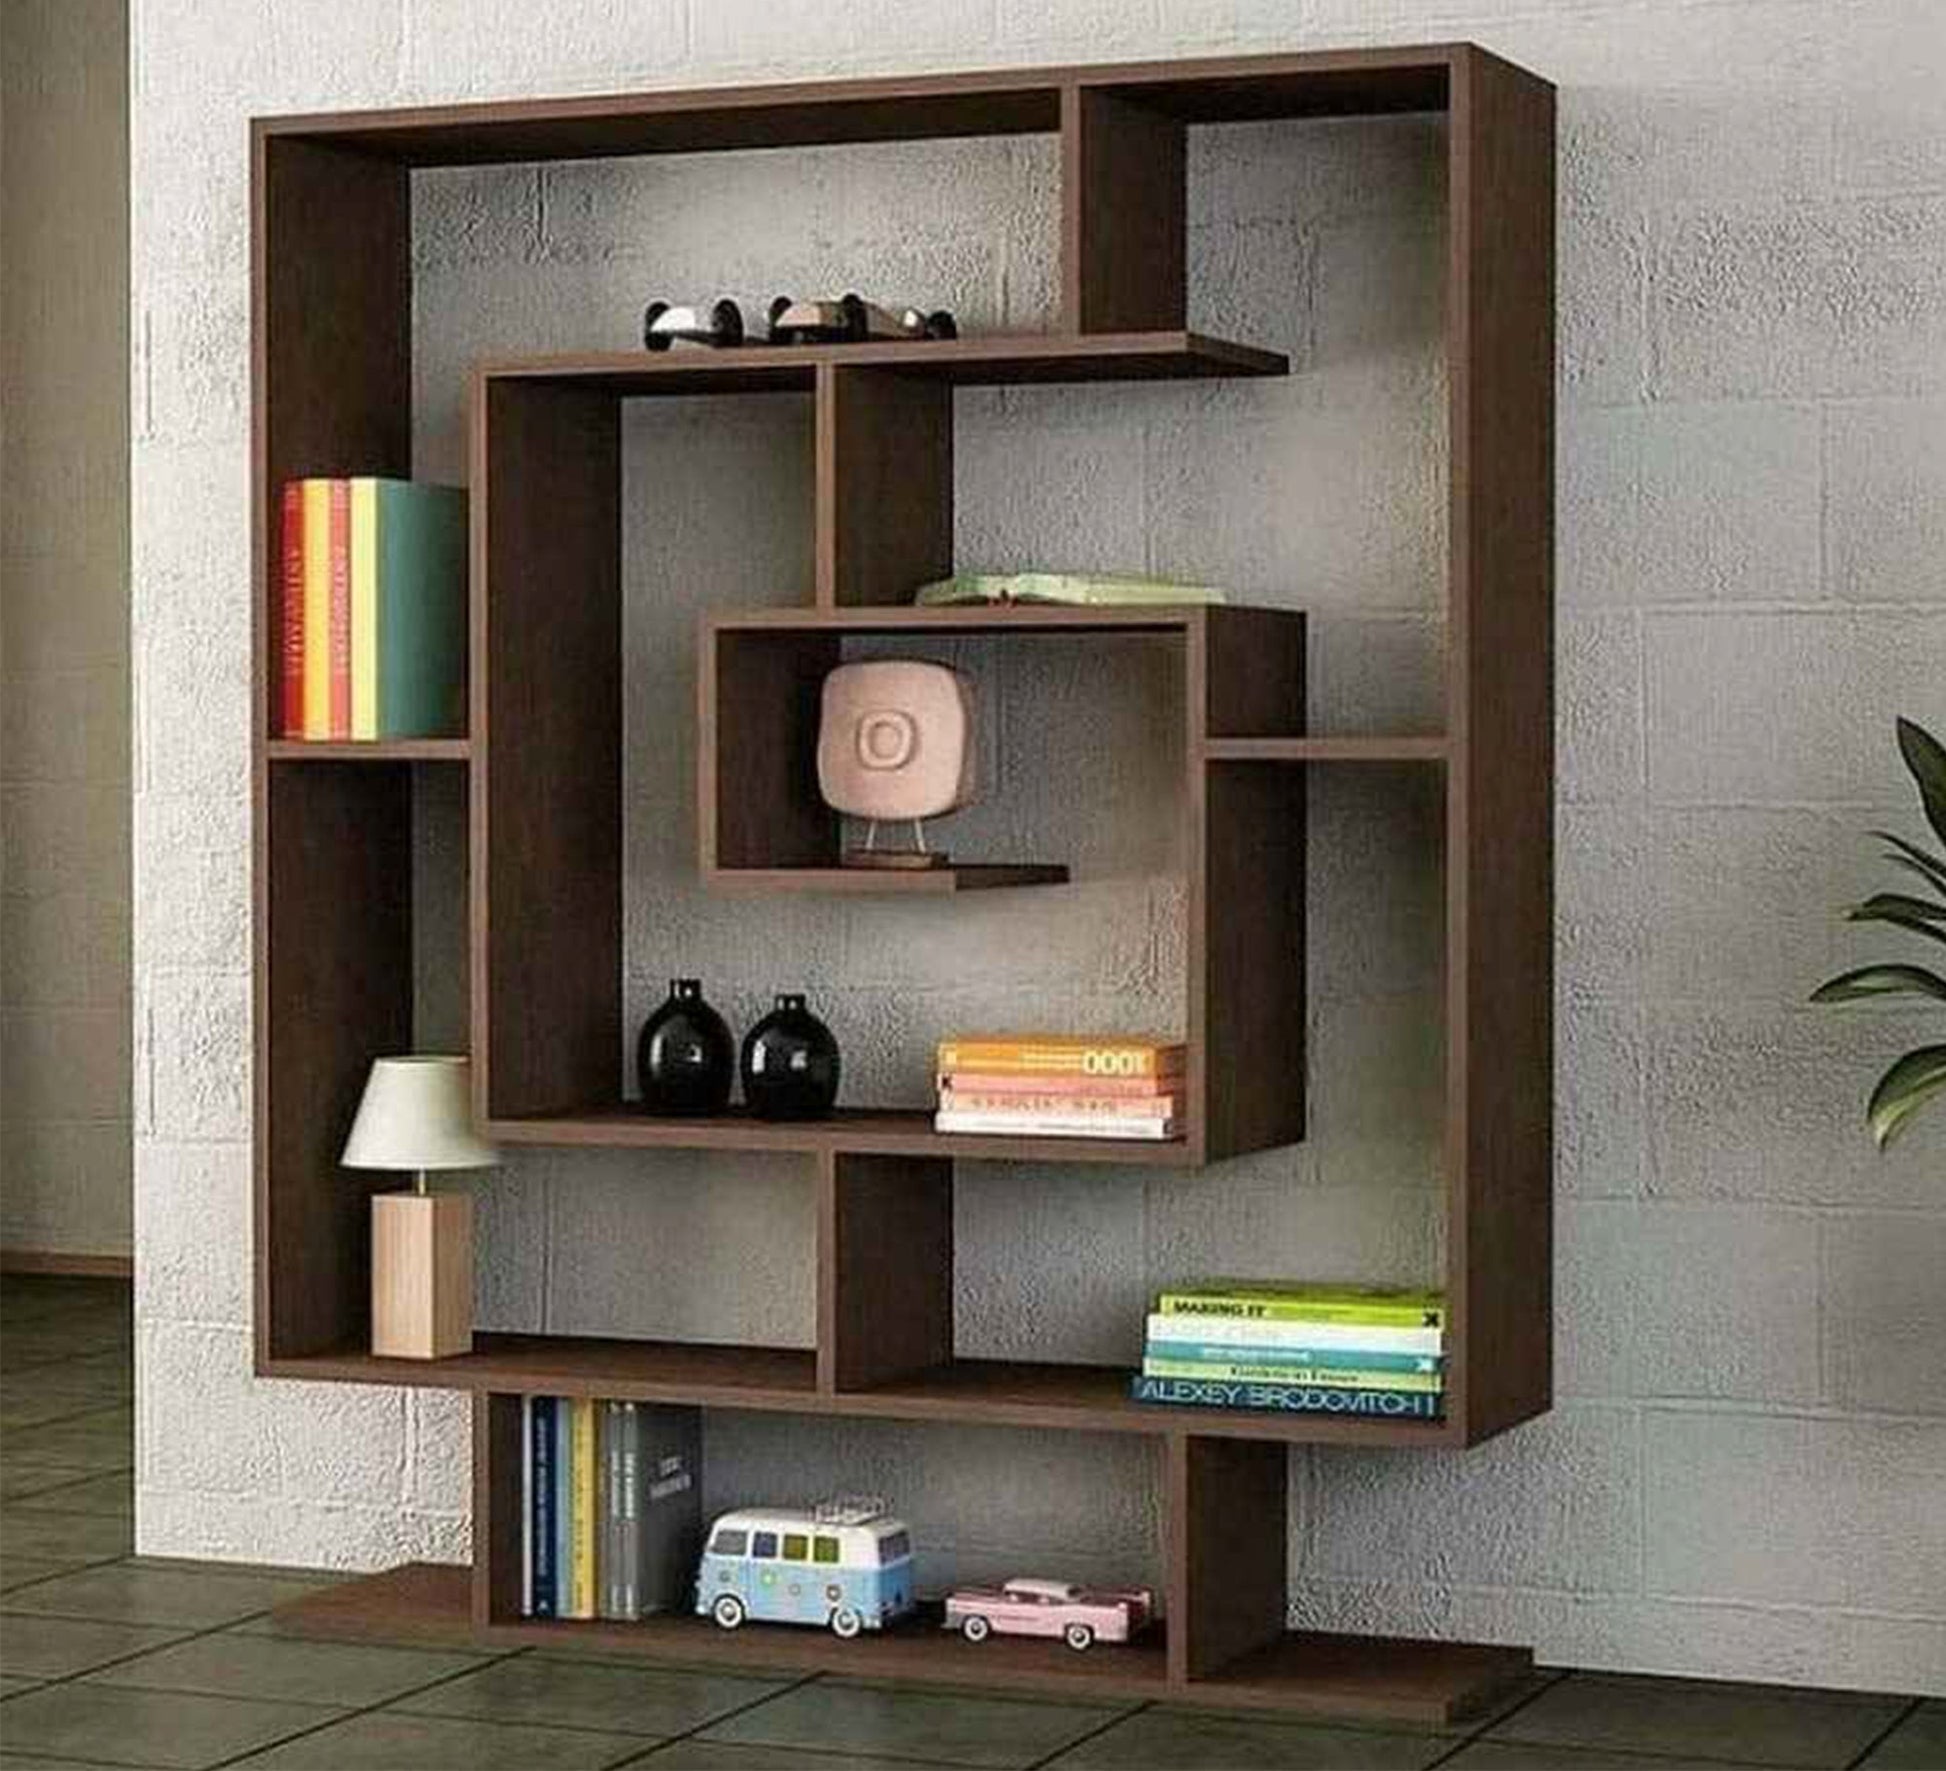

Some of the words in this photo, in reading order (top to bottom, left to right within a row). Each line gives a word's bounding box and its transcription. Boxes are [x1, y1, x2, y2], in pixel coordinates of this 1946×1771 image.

[1174, 1300, 1244, 1317] MAKING
[1247, 1305, 1266, 1318] IT
[1141, 1379, 1243, 1406] ALEXEY
